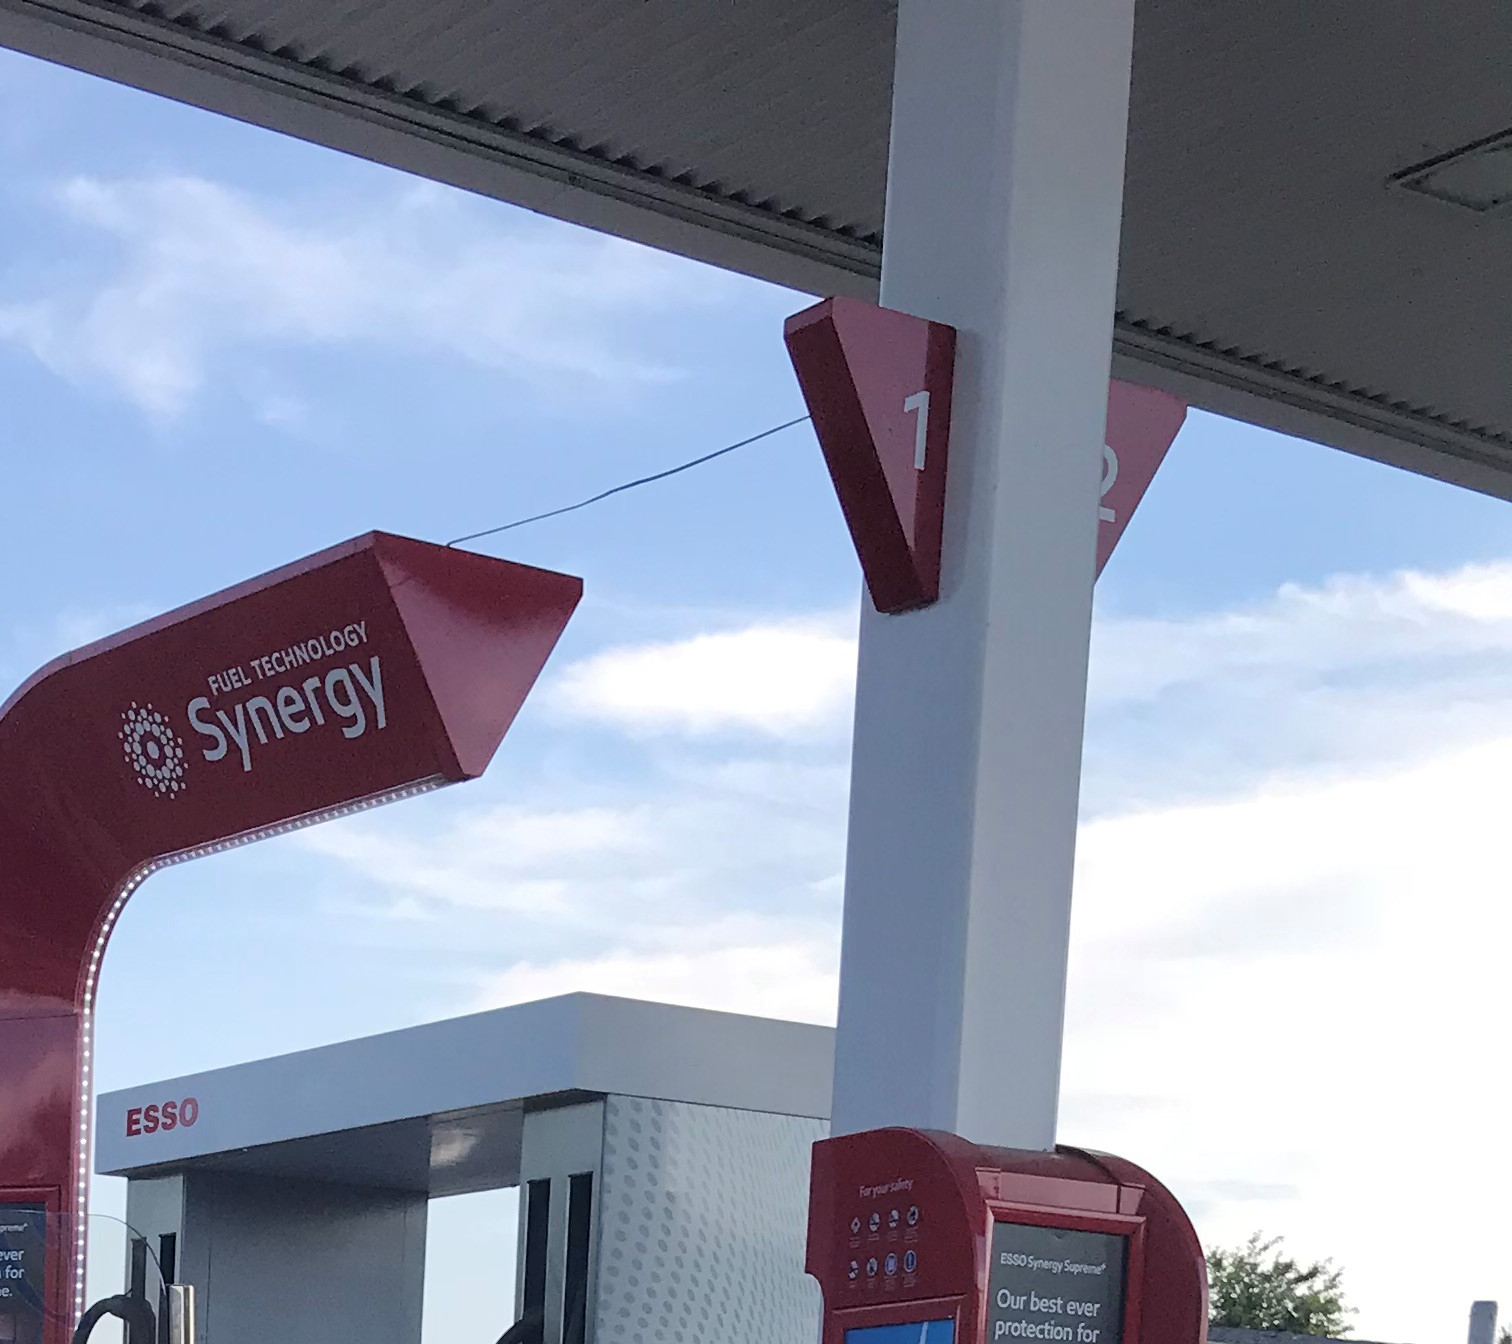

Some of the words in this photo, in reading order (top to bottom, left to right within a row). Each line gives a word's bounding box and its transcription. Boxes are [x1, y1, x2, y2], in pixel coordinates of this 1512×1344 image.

[903, 390, 931, 471] 1
[207, 660, 253, 696] FUEL
[249, 620, 370, 681] TECHNOLOGY
[187, 655, 387, 773] Synergy
[125, 1096, 199, 1138] ESSO
[4, 1264, 25, 1281] for
[1000, 1252, 1027, 1267] ESSO
[1027, 1255, 1064, 1274] Synergy
[996, 1288, 1028, 1310] Our
[1029, 1290, 1064, 1314] best
[1066, 1300, 1101, 1318] ever
[993, 1320, 1073, 1341] protection
[1076, 1322, 1101, 1344] for
